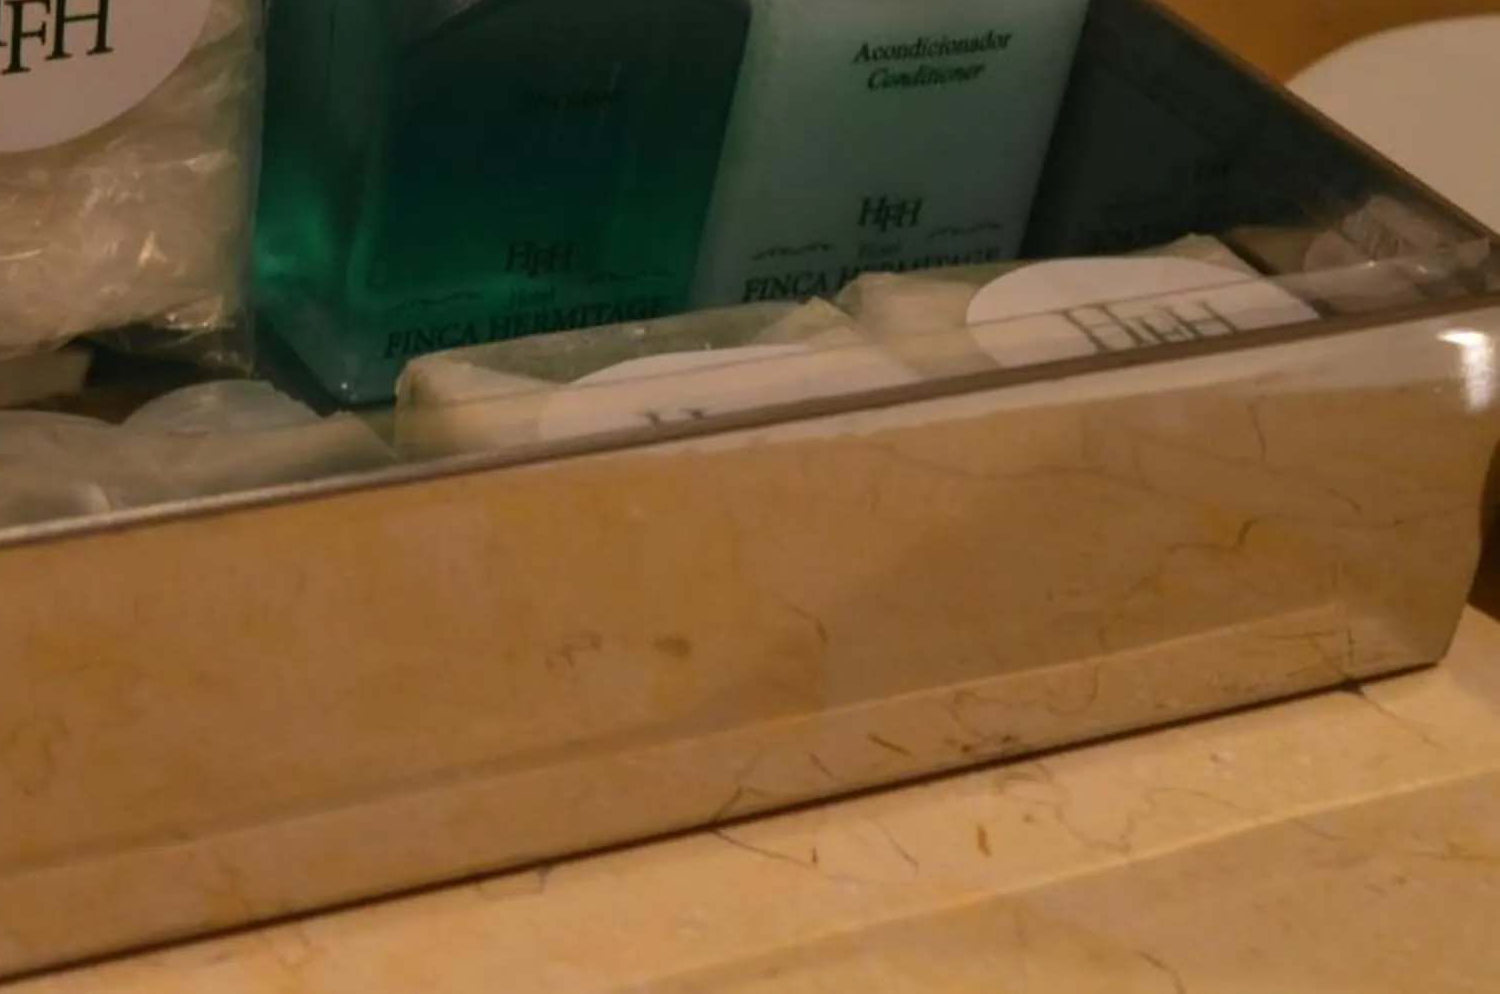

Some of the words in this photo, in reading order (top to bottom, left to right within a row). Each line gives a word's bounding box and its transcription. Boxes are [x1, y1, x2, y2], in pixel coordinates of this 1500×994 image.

[852, 30, 1012, 64] Acondicionador
[866, 61, 986, 91] Conditioner
[857, 195, 925, 233] HFH
[504, 241, 578, 277] HFH
[742, 271, 828, 303] FINCA
[383, 322, 479, 359] FINCA
[490, 294, 672, 341] HERMITAGE
